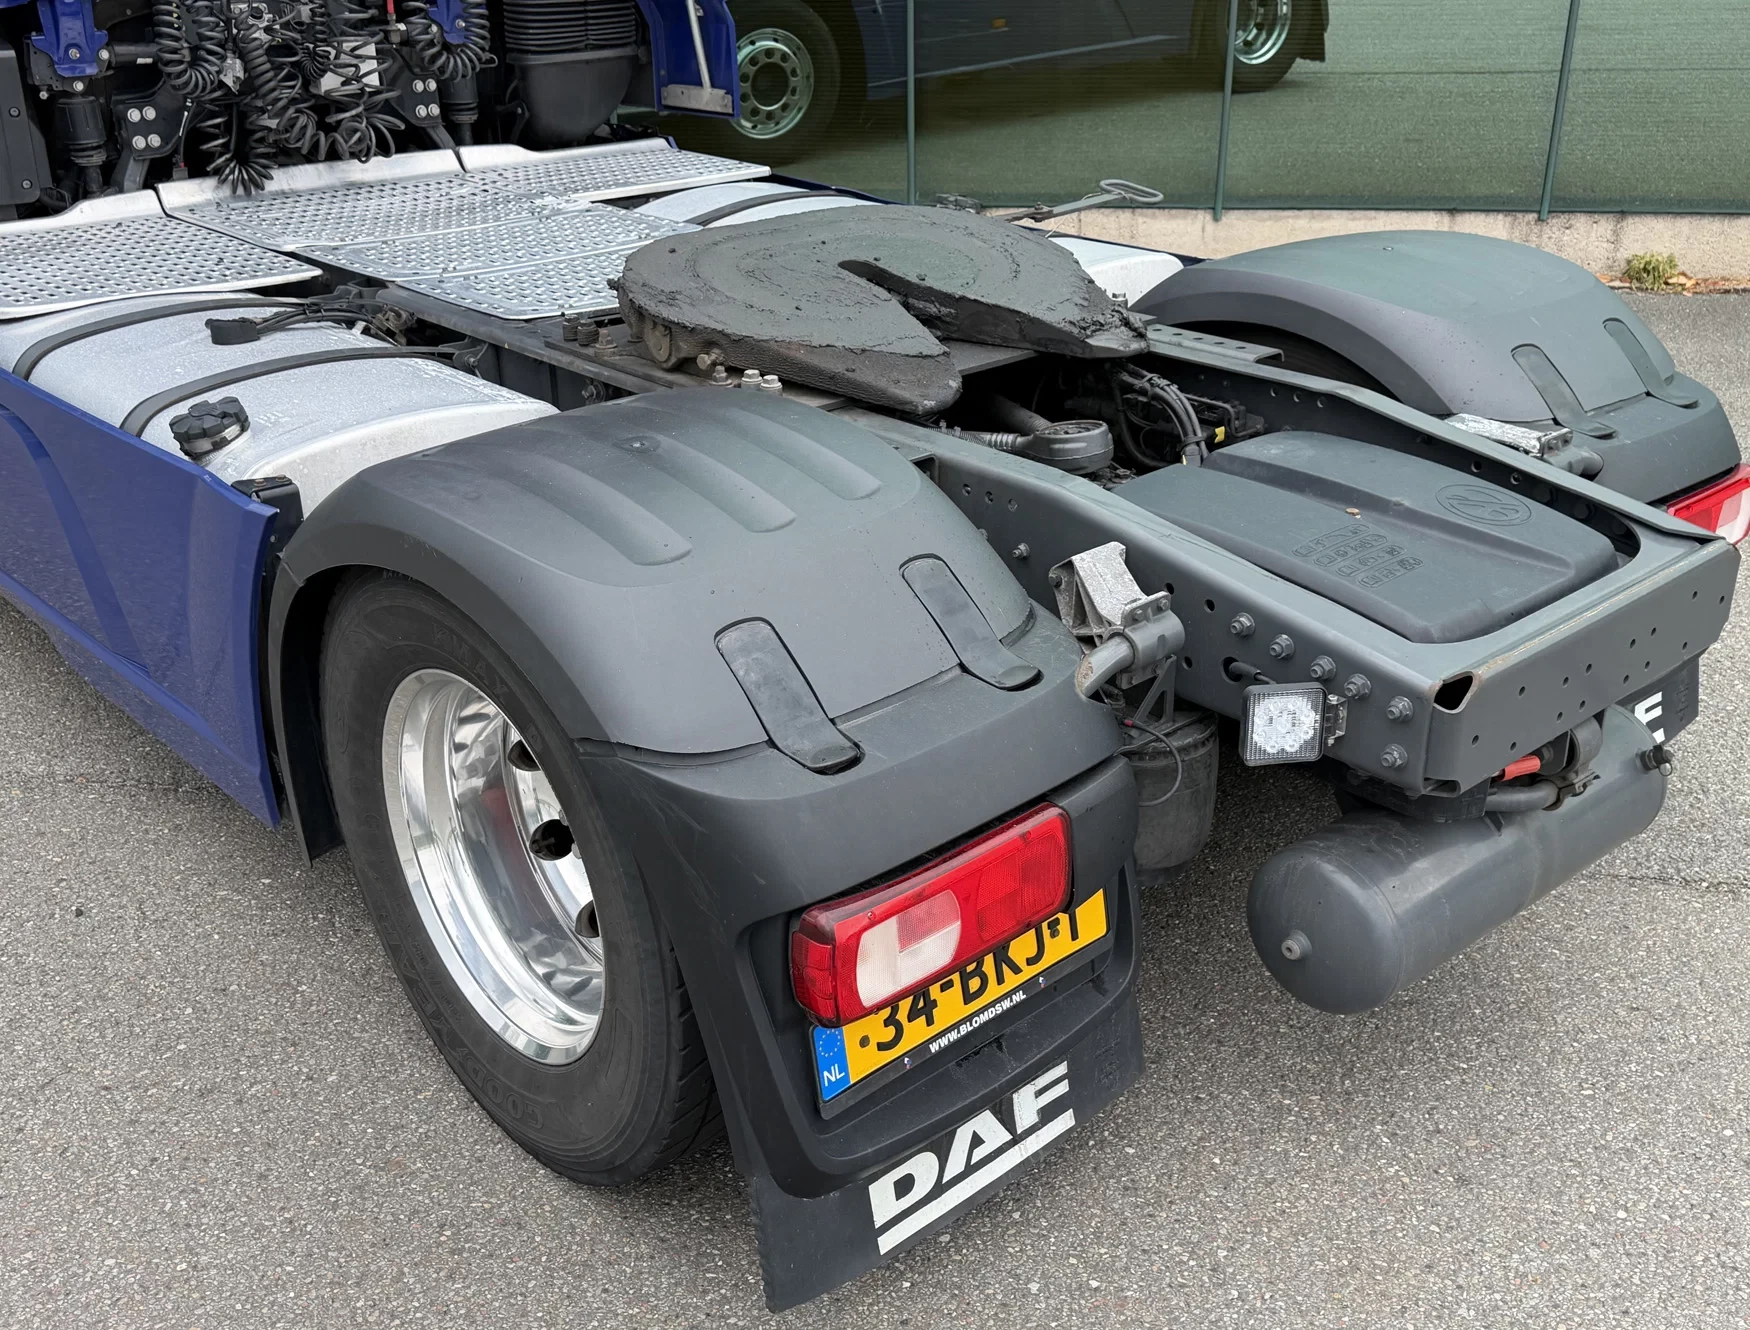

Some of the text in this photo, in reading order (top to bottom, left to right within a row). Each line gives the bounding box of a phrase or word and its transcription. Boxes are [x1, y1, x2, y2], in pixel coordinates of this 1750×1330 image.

[928, 989, 1027, 1053] WWW.BLOMDSW.NL
[823, 1063, 845, 1087] NL
[868, 1060, 1069, 1228] DAF
